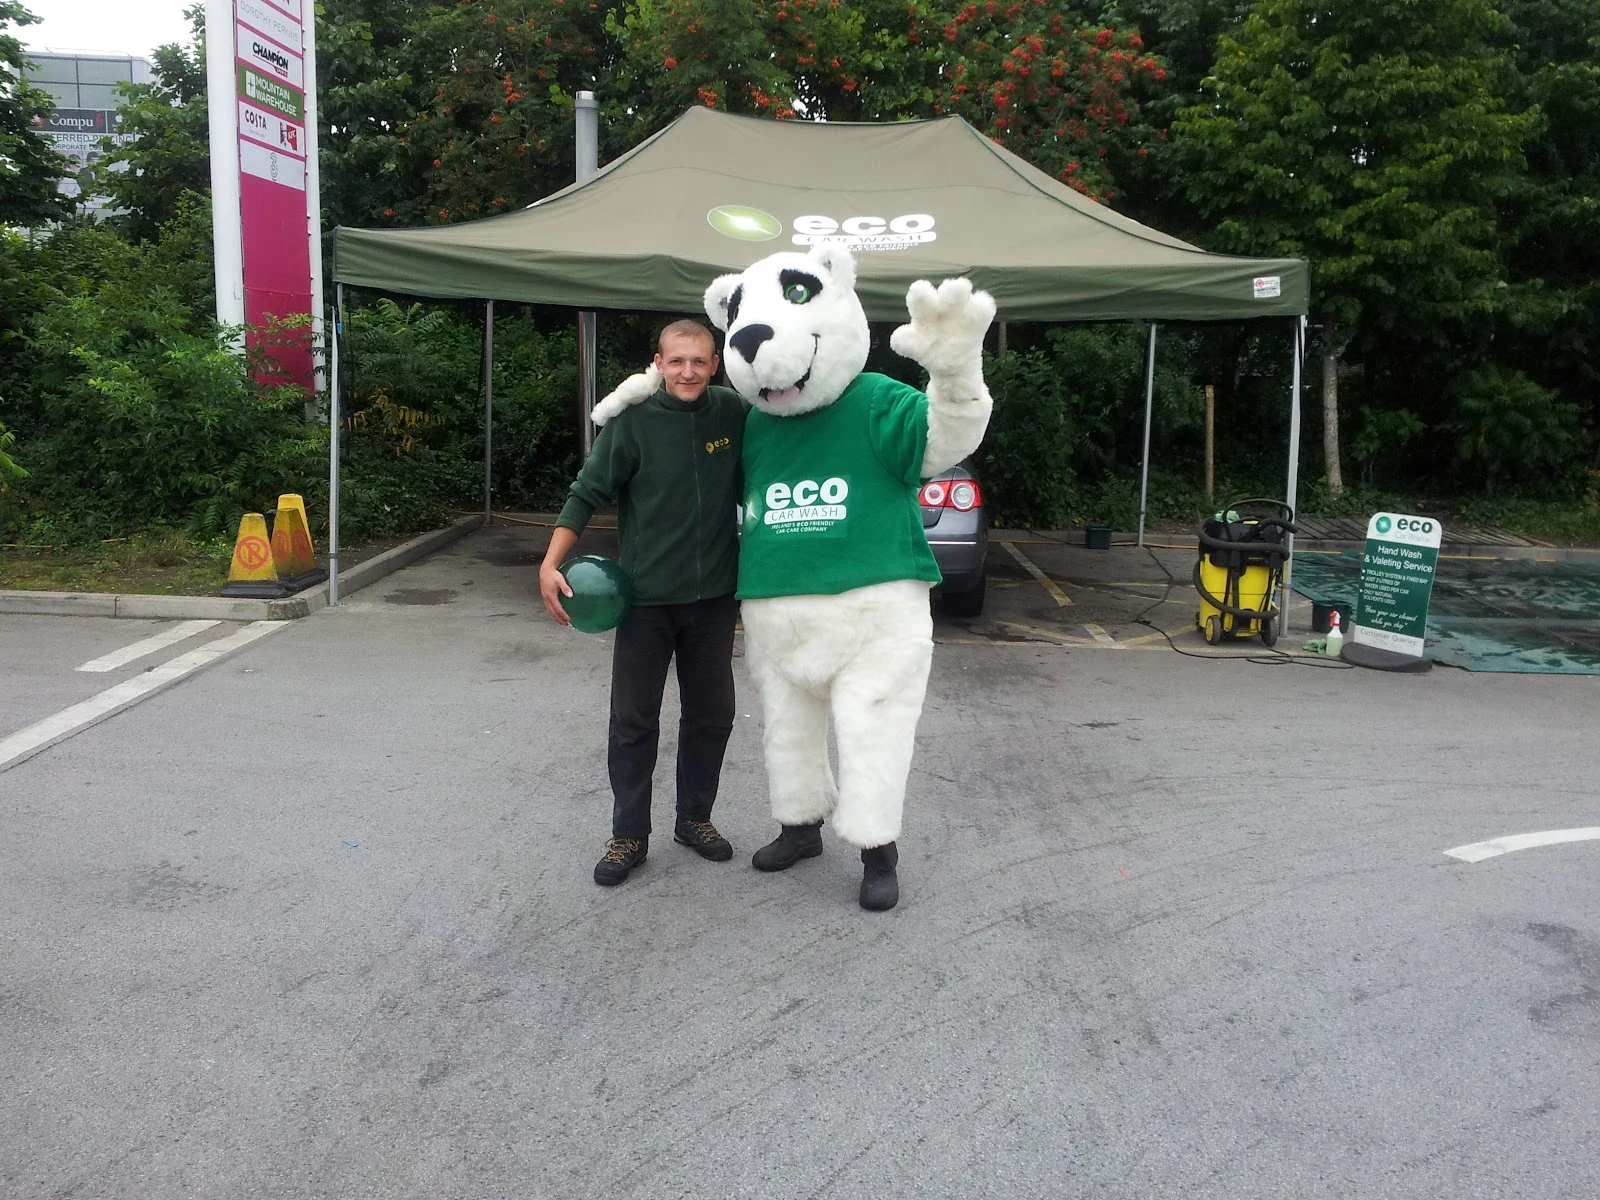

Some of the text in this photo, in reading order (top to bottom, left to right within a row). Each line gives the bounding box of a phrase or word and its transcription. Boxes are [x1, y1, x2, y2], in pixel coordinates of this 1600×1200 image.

[240, 1, 299, 42] DOROTHY PERKINS
[252, 41, 289, 70] CHAMPION
[255, 73, 290, 101] MOUNTAIN
[255, 88, 297, 117] WAREHOUSE
[50, 113, 94, 130] Compu
[245, 109, 267, 130] COSTA
[287, 129, 296, 140] KFC
[792, 213, 936, 235] eco
[766, 477, 849, 510] eco
[771, 506, 838, 521] CAR WASH
[1397, 518, 1433, 534] eco
[1377, 545, 1423, 560] Hand Wash
[1364, 554, 1433, 573] & Valeting Service
[1364, 582, 1379, 590] WATER
[1363, 594, 1384, 603] SOLVENTS
[1374, 591, 1393, 599] NATURAL
[1360, 628, 1390, 639] Customer
